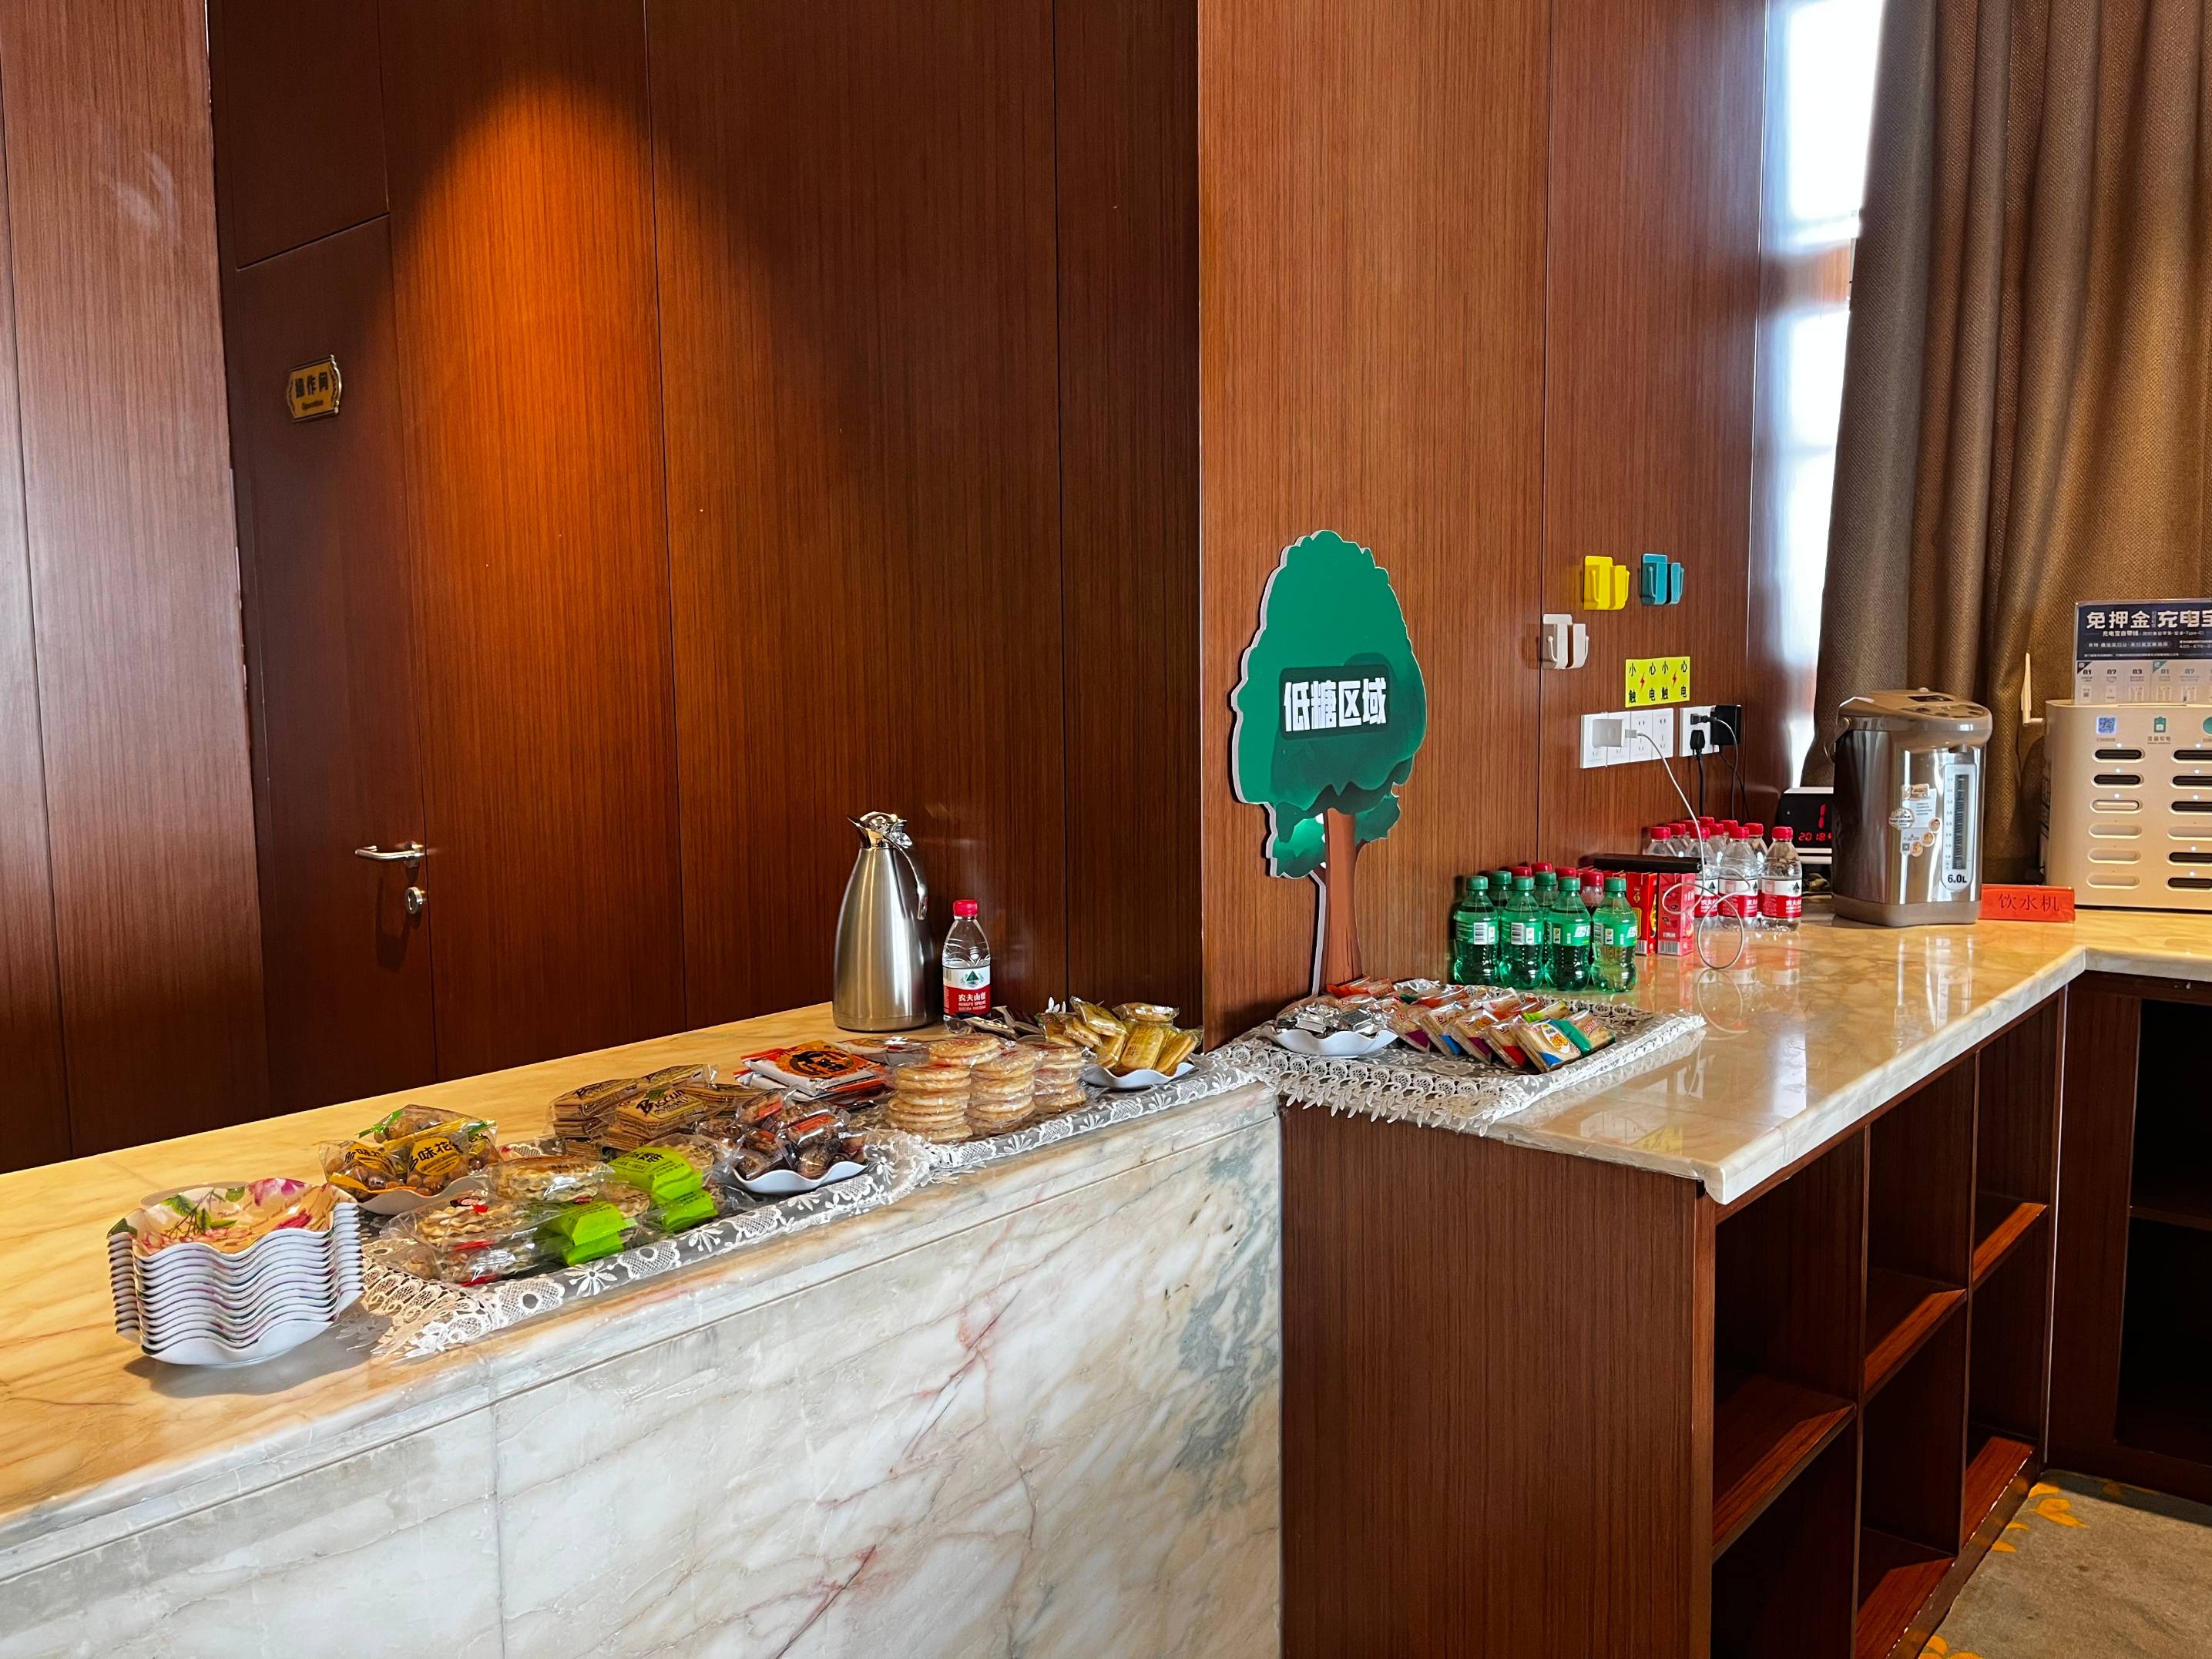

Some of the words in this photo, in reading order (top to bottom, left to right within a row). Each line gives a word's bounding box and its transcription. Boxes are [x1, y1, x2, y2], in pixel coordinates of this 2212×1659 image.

[2086, 610, 2150, 629] 免押金
[1629, 662, 1656, 677] 小心
[1662, 660, 1687, 675] 小心
[1284, 677, 1387, 732] 低糖区域
[1948, 874, 1967, 883] 6.0L
[1998, 894, 2059, 912] 饮水机
